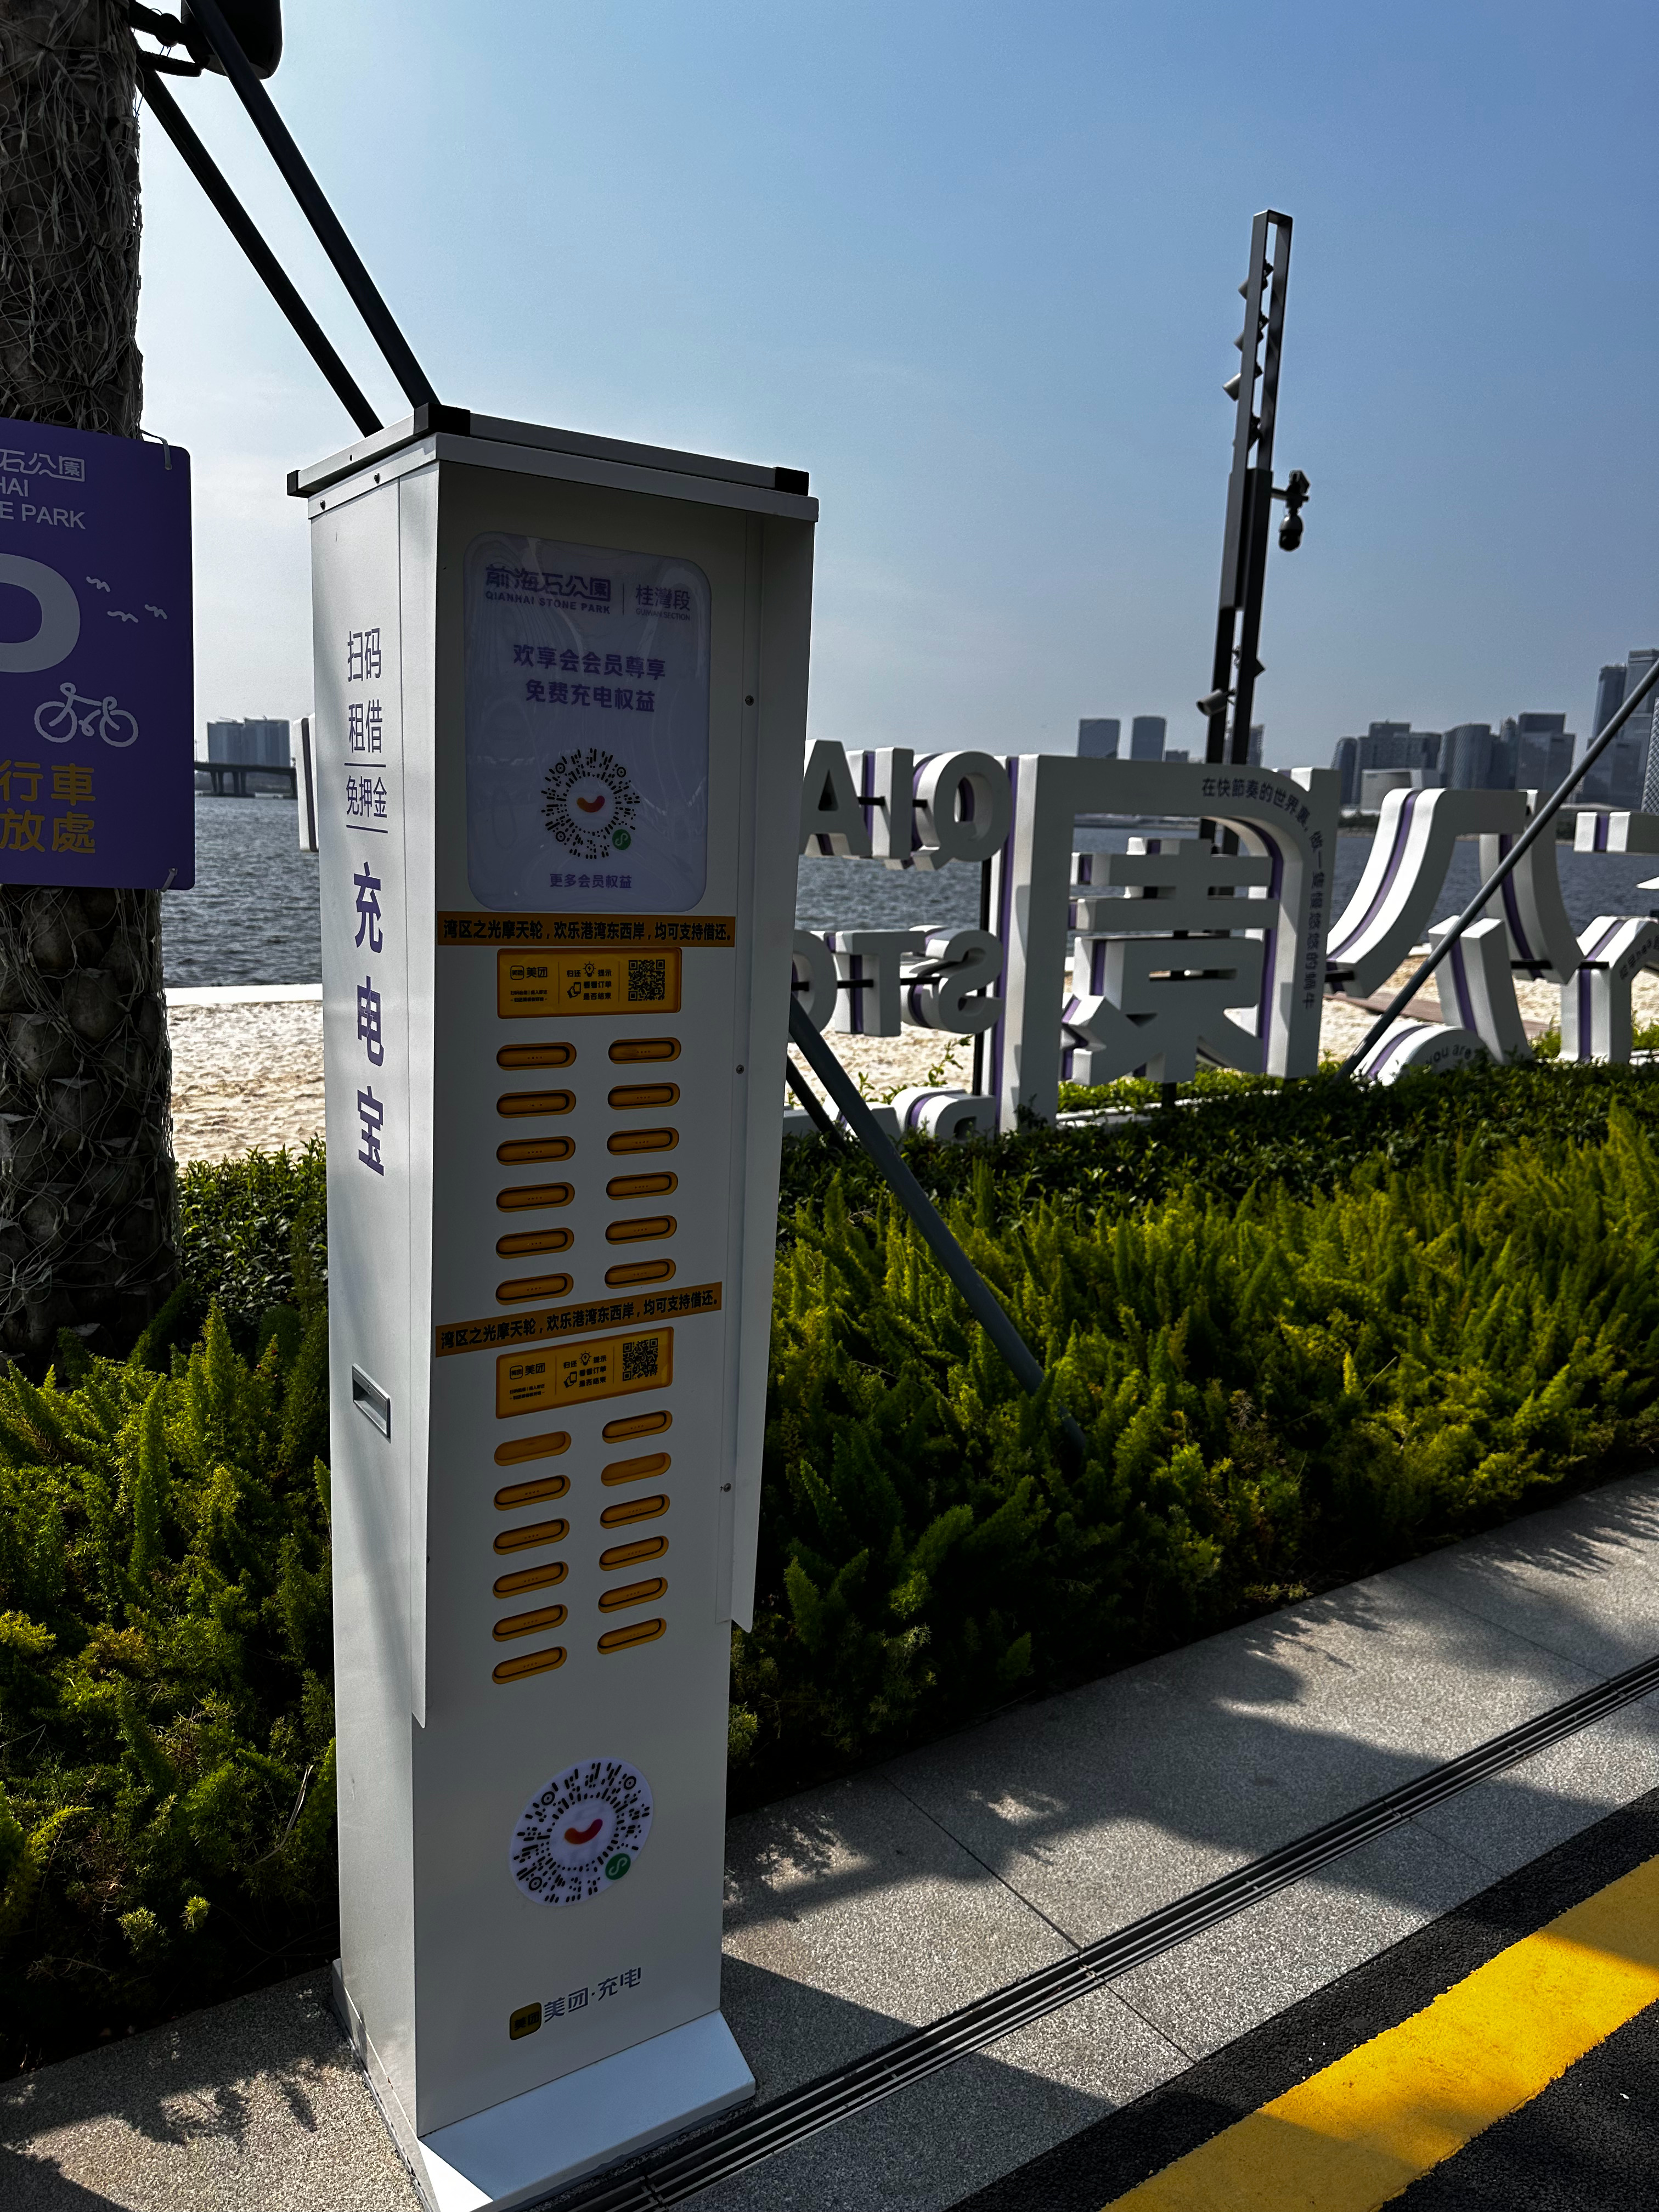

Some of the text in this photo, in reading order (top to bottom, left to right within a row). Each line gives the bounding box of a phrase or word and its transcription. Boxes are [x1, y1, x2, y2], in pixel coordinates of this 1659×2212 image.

[21, 503, 86, 529] PARK
[486, 591, 611, 614] QIANHAI STONE PARK
[636, 607, 691, 621] GUIWAN SECTION
[347, 628, 382, 682] 扫码
[513, 644, 666, 680] 欢享会会员尊享
[526, 679, 656, 713] 免费充电权益
[348, 698, 383, 755] 租借
[0, 759, 97, 806] 行車
[346, 774, 388, 821] 免押金
[0, 808, 95, 854] 放處
[550, 873, 633, 889] 更多会员权益
[526, 967, 548, 978] 美团
[598, 969, 612, 977] 提示
[583, 992, 612, 1001] 是否结束
[525, 1362, 545, 1376] 美团
[544, 1967, 641, 2023] 美团·充电
[514, 2011, 540, 2032] 美团
